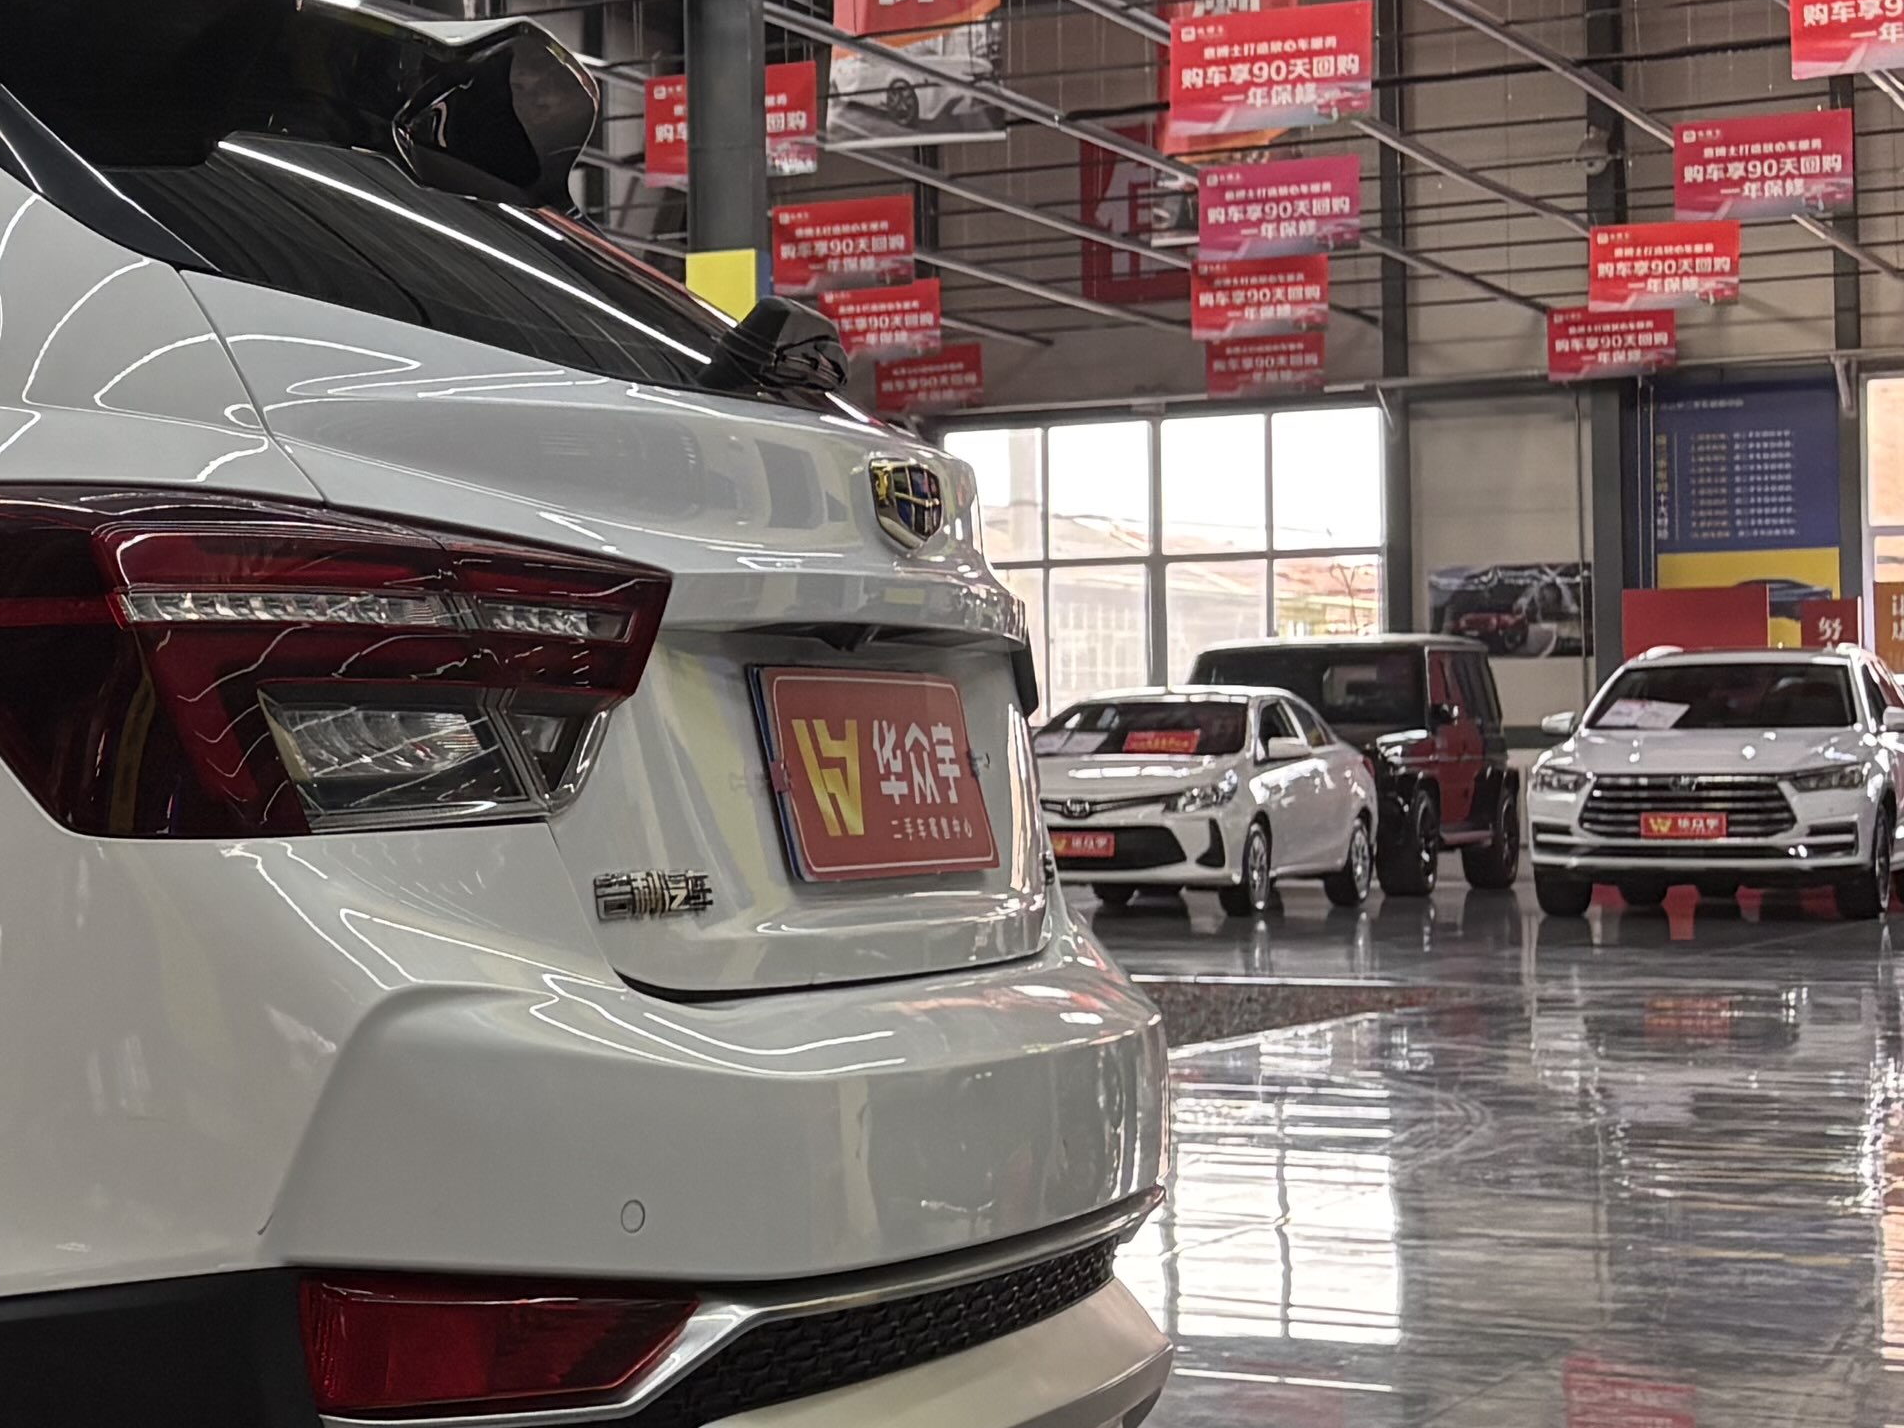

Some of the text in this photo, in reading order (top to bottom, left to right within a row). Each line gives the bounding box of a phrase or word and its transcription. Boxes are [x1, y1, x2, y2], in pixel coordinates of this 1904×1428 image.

[1180, 53, 1361, 90] 购车享90天回购
[1221, 81, 1319, 108] 一年保修
[1683, 153, 1844, 184] 购车享90天回购
[1719, 177, 1806, 200] 一年保修
[1206, 195, 1352, 225] 购车享90天回购
[1240, 219, 1318, 240] 一年保修
[779, 234, 906, 261] 购车享90天回购
[1596, 255, 1732, 280] 购车享90天回购
[1198, 284, 1322, 308] 购车享90天回购
[832, 311, 935, 333] 车享90天回购
[872, 718, 962, 806] 华众宇
